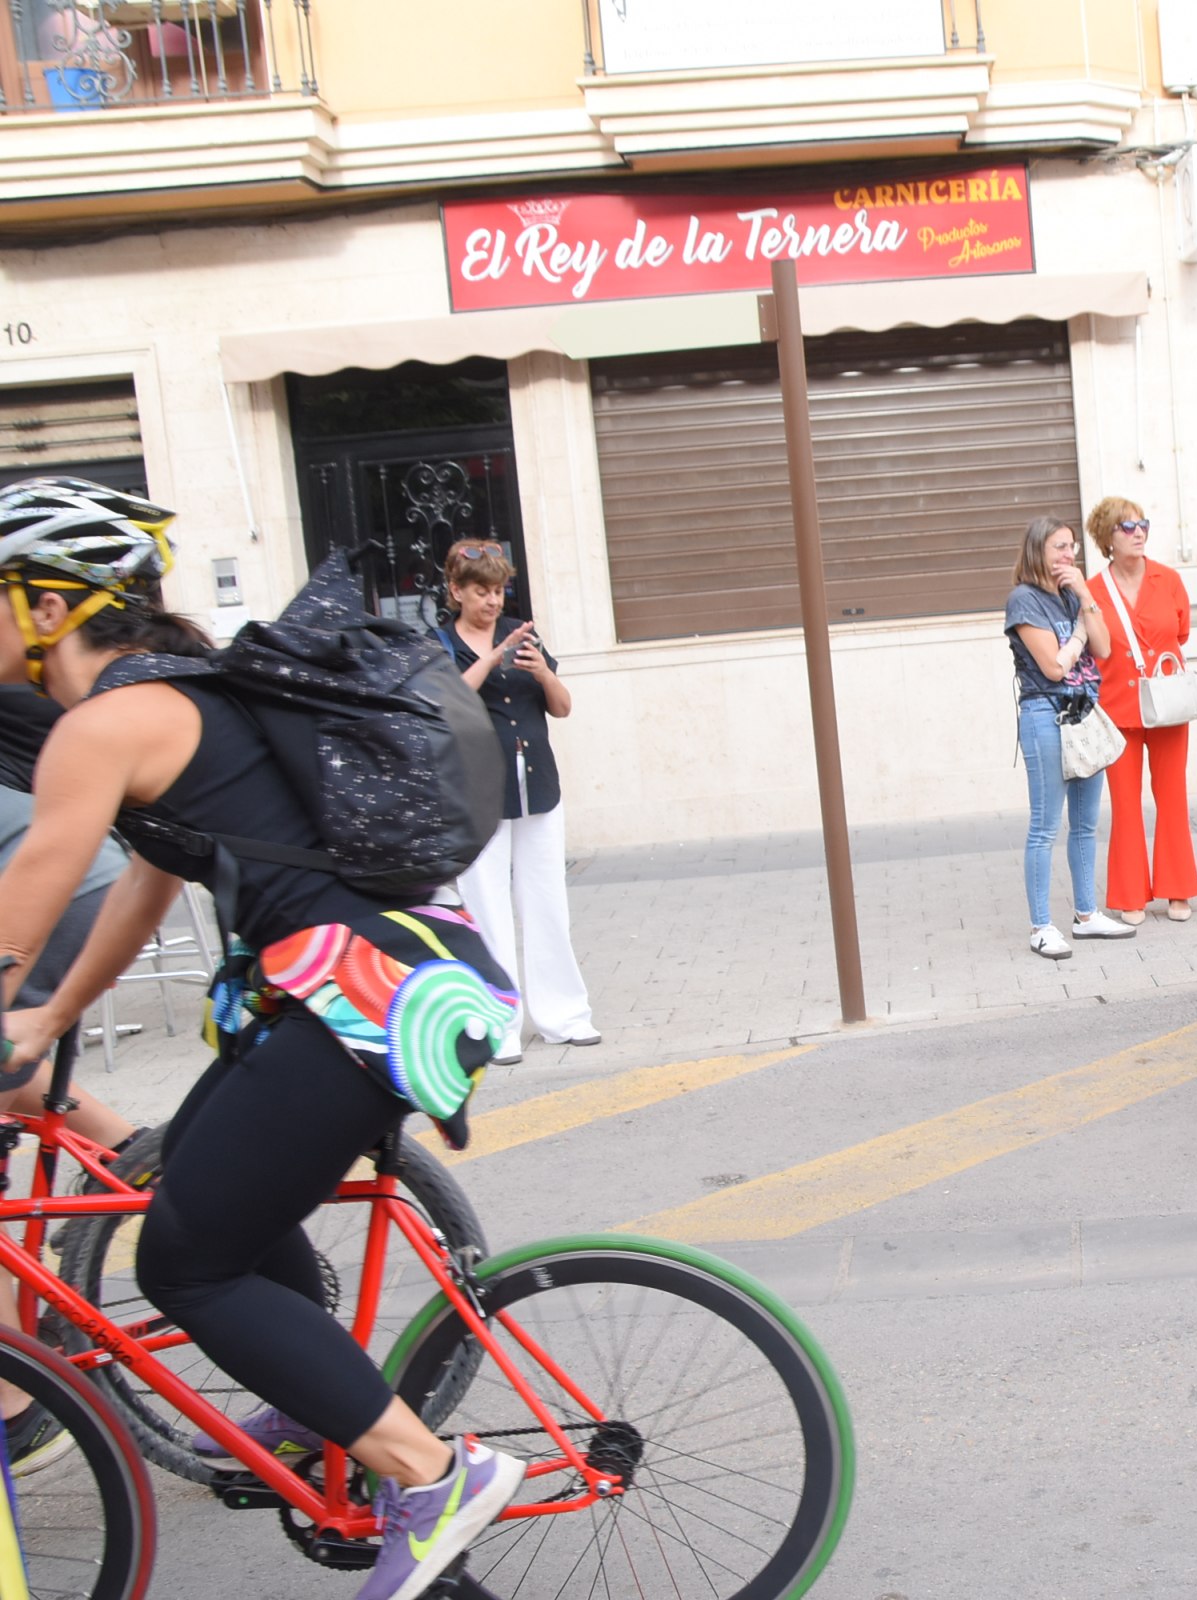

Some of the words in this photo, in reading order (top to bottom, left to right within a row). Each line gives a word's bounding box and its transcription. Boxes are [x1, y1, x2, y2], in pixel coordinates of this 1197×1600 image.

[833, 170, 1022, 210] CARNICERÍA
[461, 228, 510, 281] El
[514, 223, 607, 298] Rey
[615, 218, 673, 269] de
[683, 215, 733, 265] la
[737, 208, 908, 261] Ternera
[917, 217, 988, 254] Productos
[948, 236, 1022, 267] Artesanos
[4, 322, 32, 345] 10
